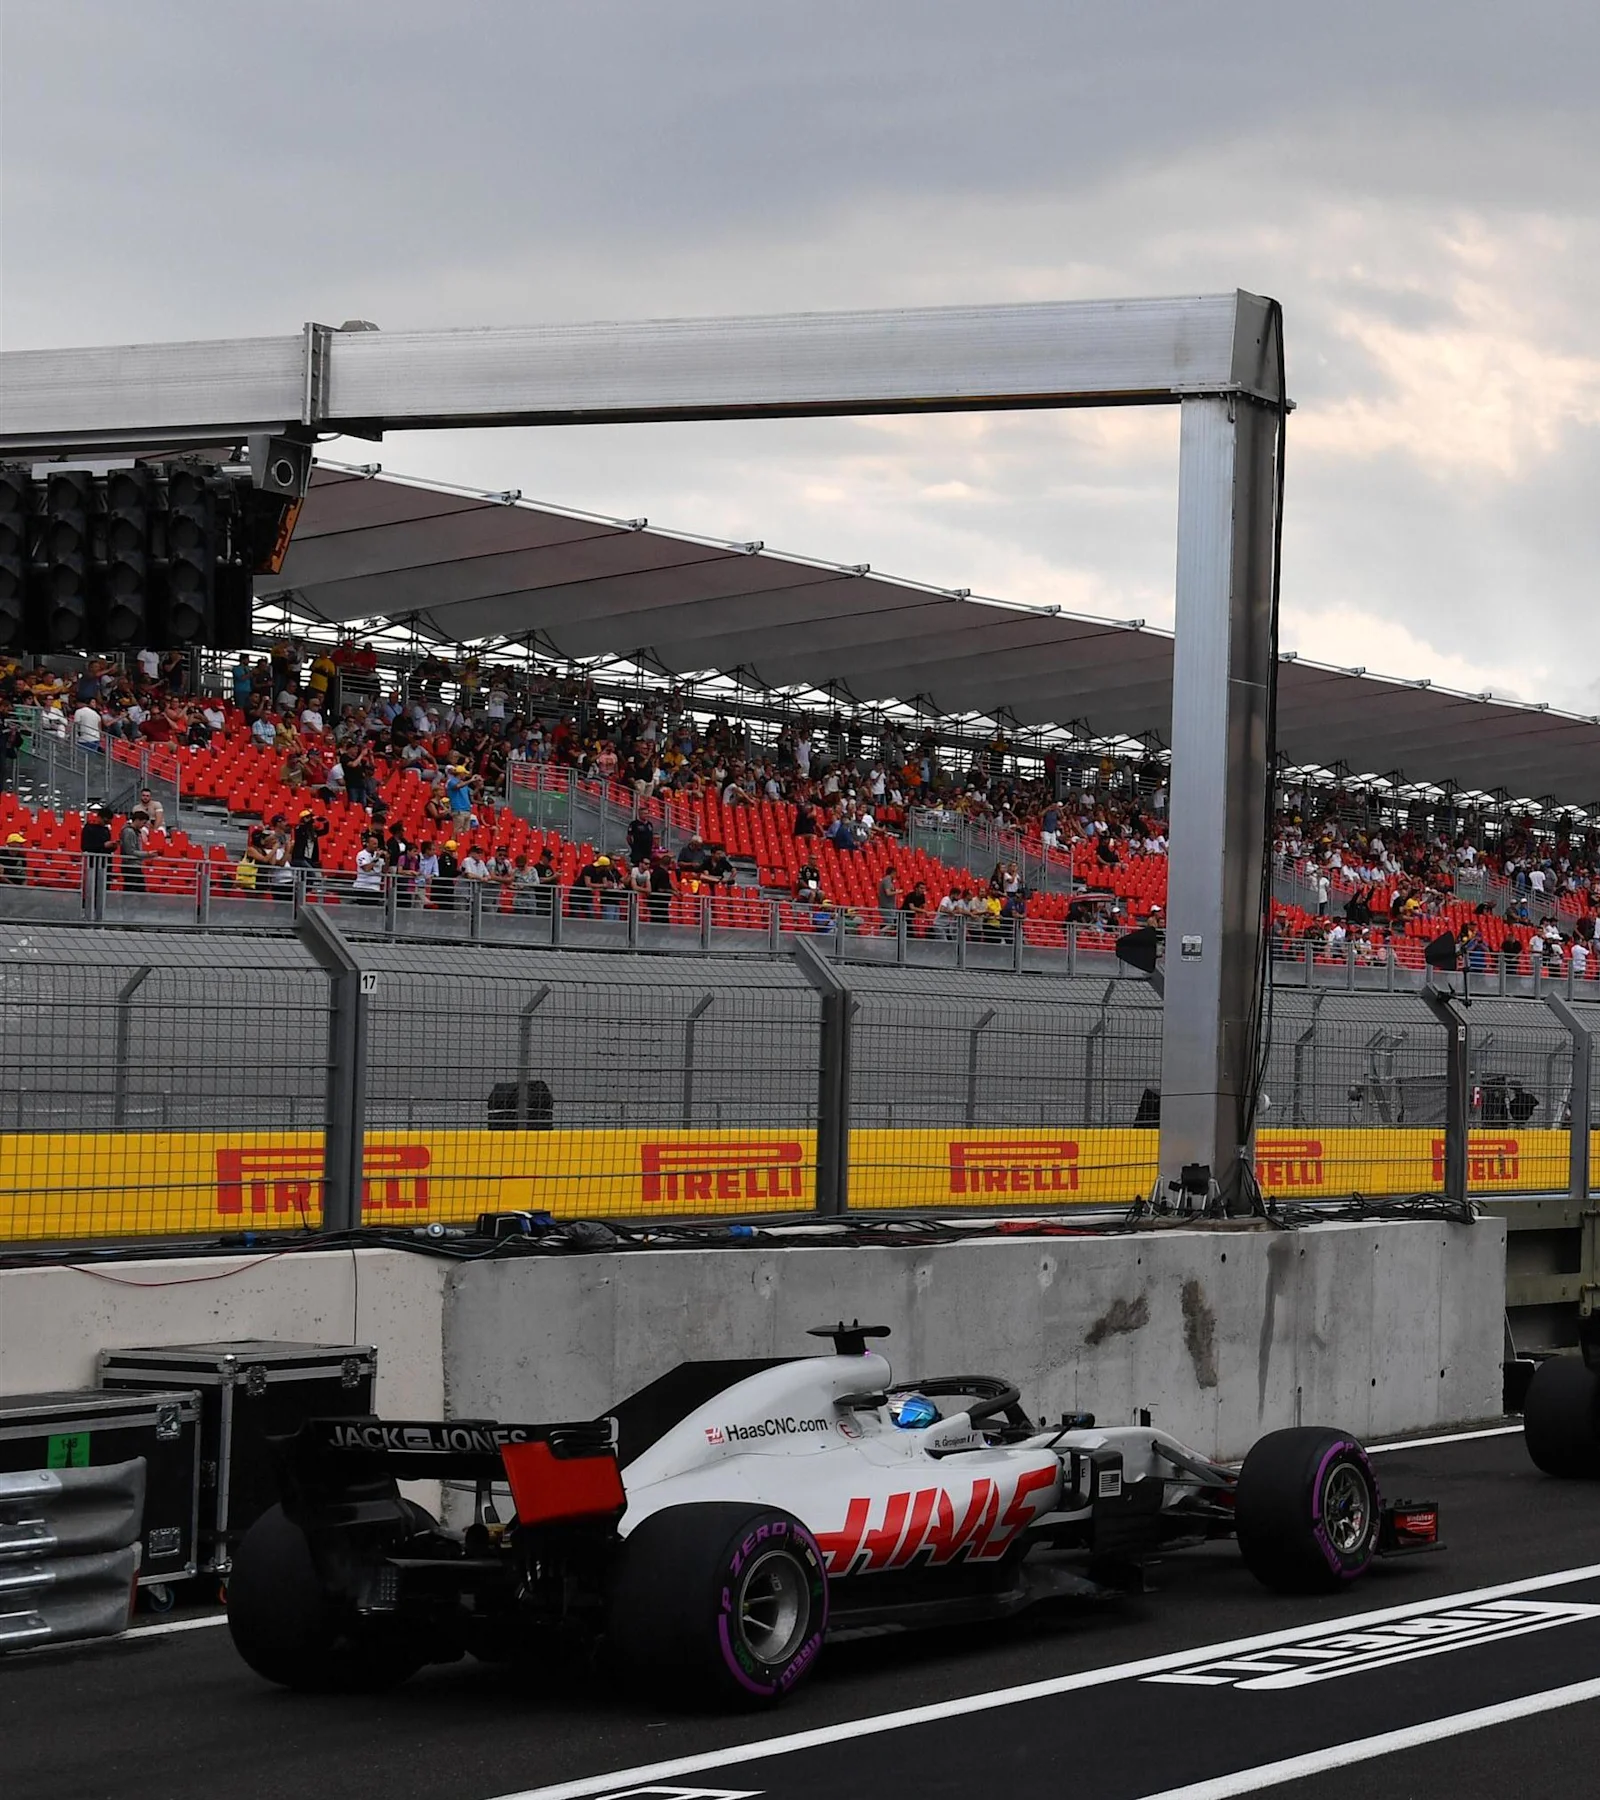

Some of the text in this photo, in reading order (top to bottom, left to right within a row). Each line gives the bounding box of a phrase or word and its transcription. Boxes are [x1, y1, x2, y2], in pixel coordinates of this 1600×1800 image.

[362, 974, 376, 990] 17
[216, 1145, 430, 1214] PIRLLI
[641, 1142, 802, 1201] PIRELLI
[949, 1141, 1079, 1193] PIRELLI
[328, 1425, 527, 1451] JACK JONES
[724, 1416, 828, 1442] HaasCNC.com
[813, 1464, 1057, 1575] HAAS
[730, 1521, 786, 1577] ZERO
